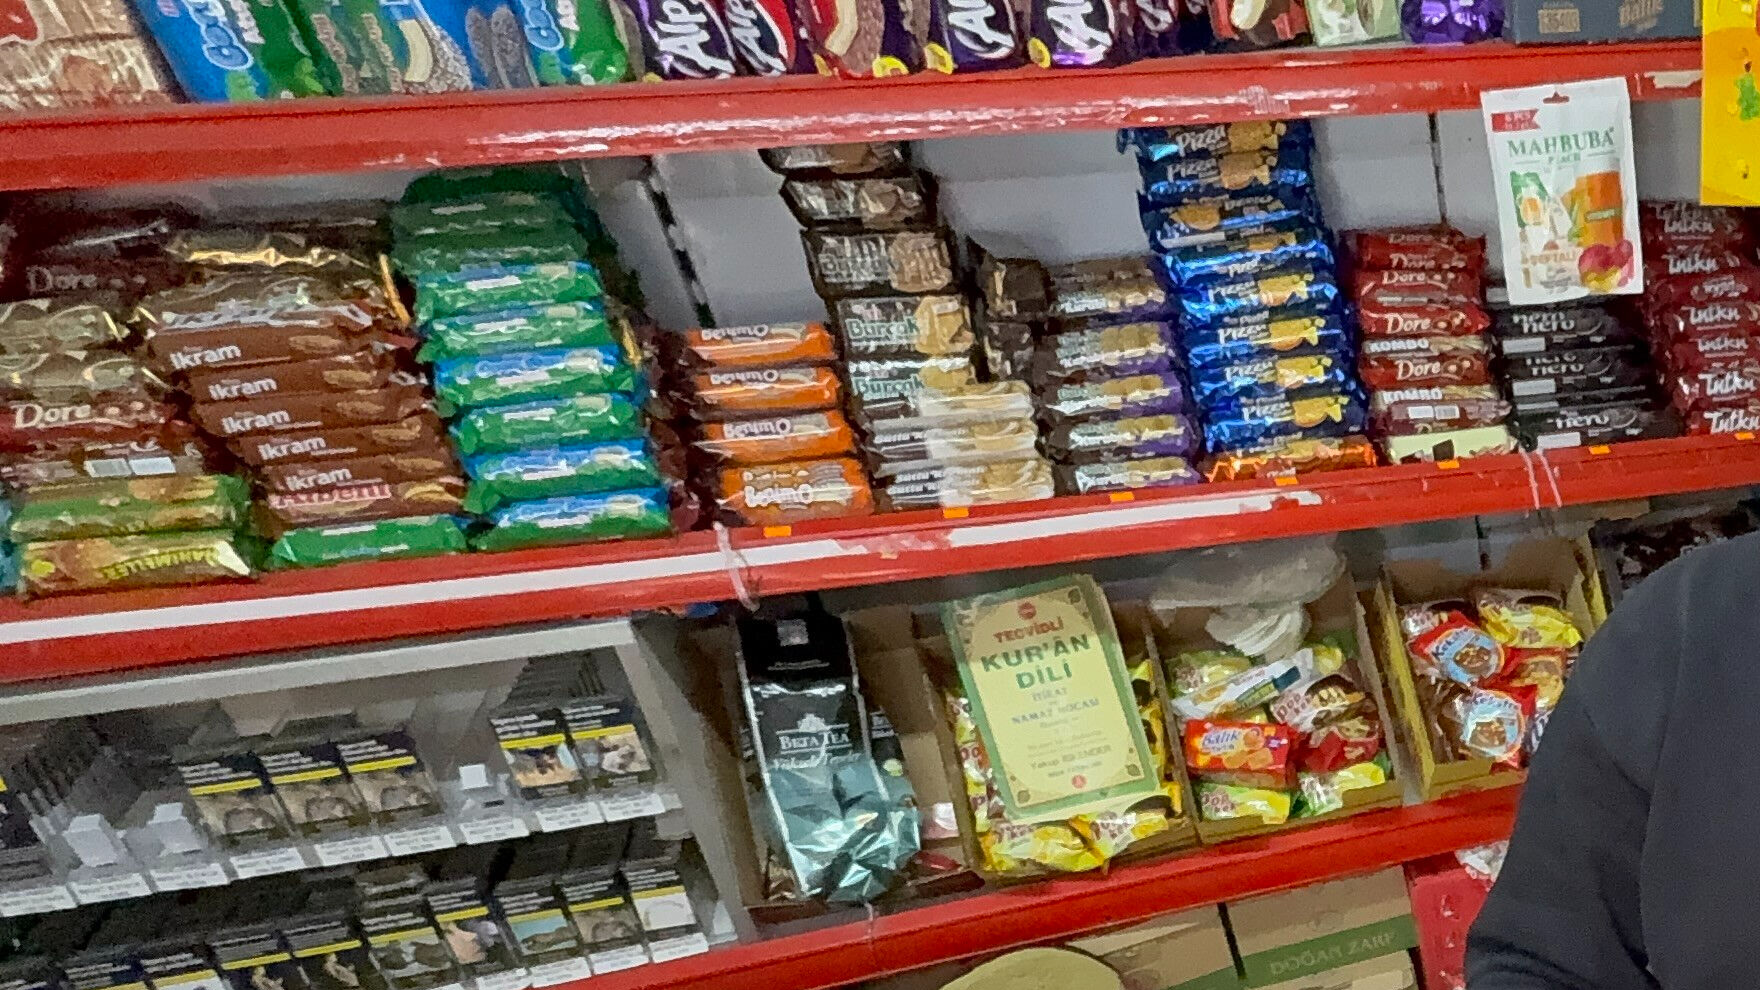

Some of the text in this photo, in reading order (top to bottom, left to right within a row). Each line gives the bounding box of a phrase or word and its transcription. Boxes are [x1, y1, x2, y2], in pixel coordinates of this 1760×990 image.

[1507, 128, 1613, 158] MAHBUBA
[1386, 313, 1431, 334] Dore
[1397, 359, 1442, 381] Dore
[10, 402, 91, 429] Dore
